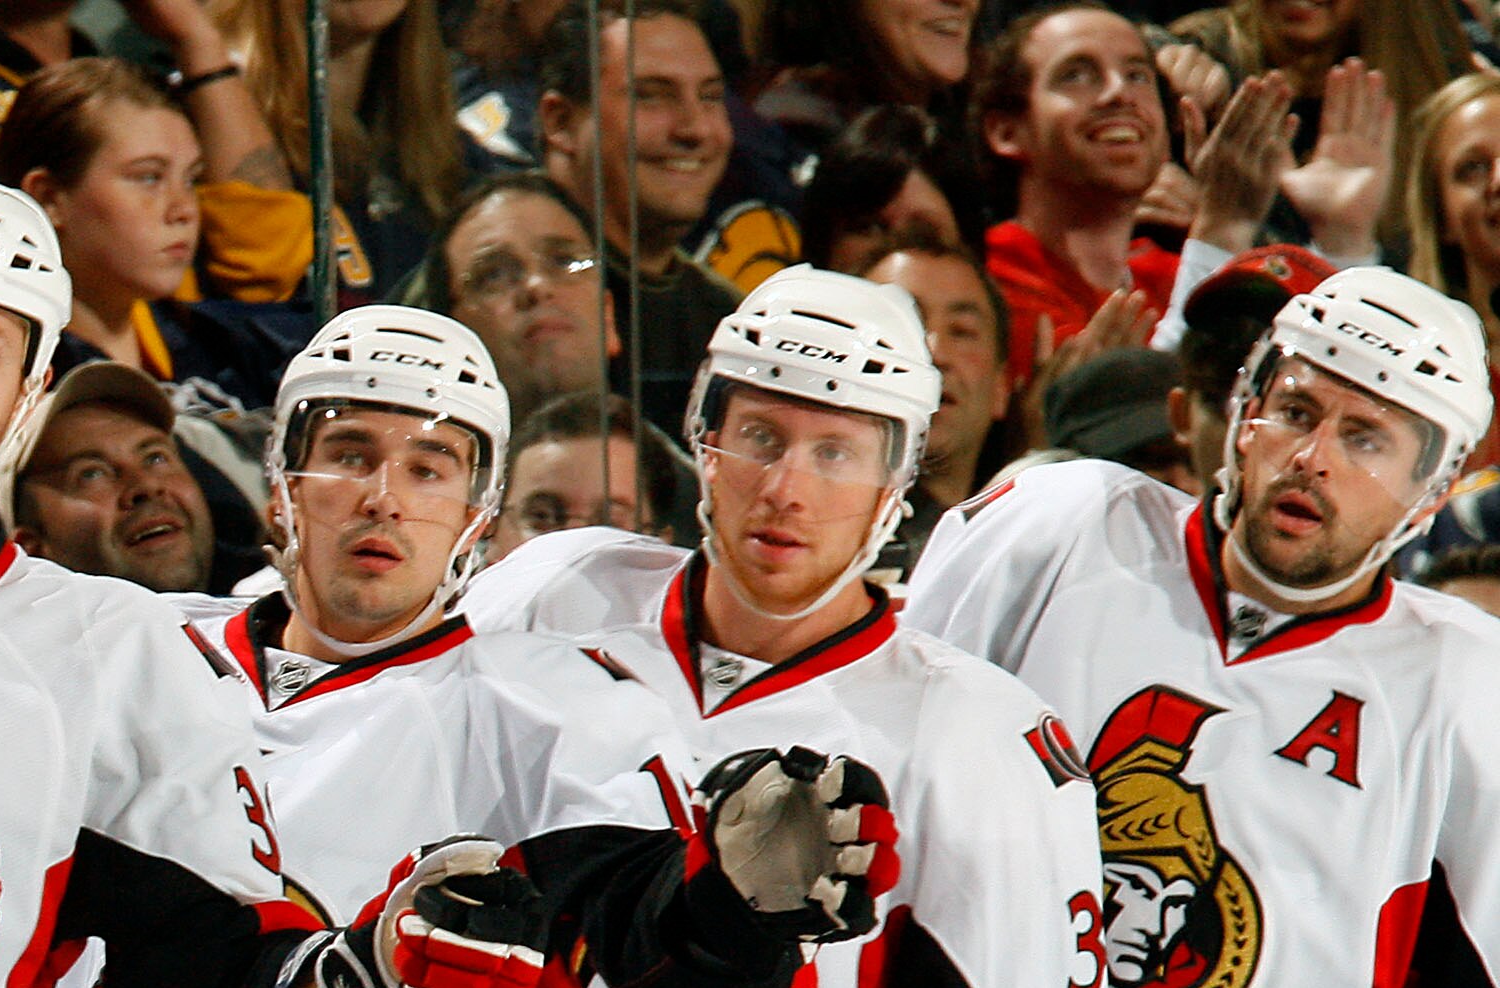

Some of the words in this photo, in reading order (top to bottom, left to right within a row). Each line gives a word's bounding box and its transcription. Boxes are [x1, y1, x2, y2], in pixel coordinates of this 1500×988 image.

[776, 338, 849, 363] CCM
[1337, 321, 1406, 357] CCM
[369, 349, 445, 370] CCM
[1271, 687, 1367, 791] A
